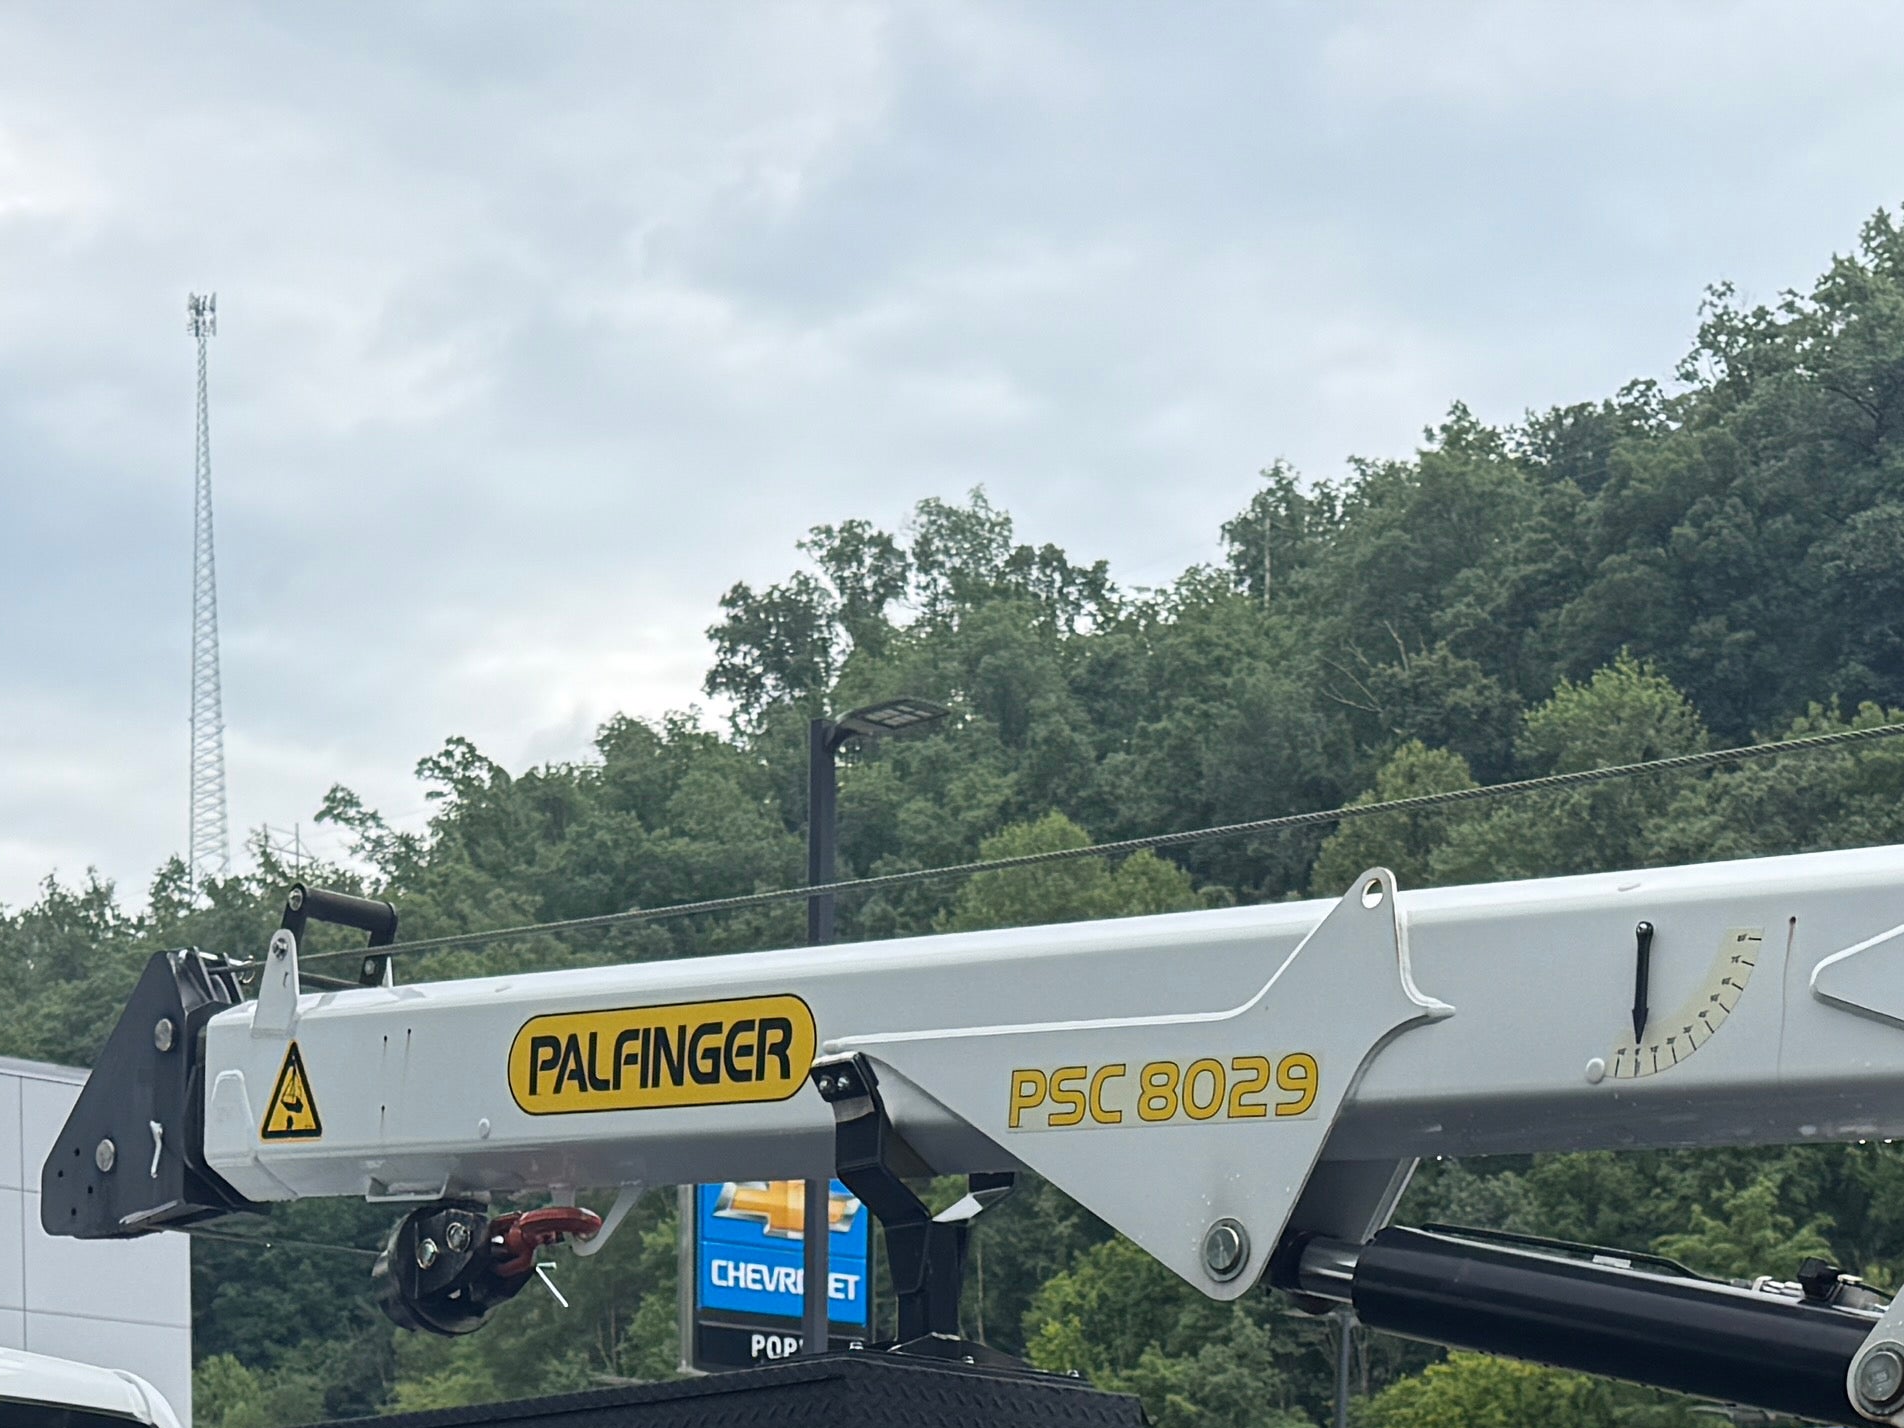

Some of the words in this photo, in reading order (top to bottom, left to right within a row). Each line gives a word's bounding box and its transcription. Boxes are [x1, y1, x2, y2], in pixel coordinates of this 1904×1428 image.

[528, 1017, 792, 1096] PALFINGER
[1008, 1063, 1126, 1128] PSC
[1137, 1052, 1319, 1121] 8029
[711, 1258, 861, 1301] CHEVRET
